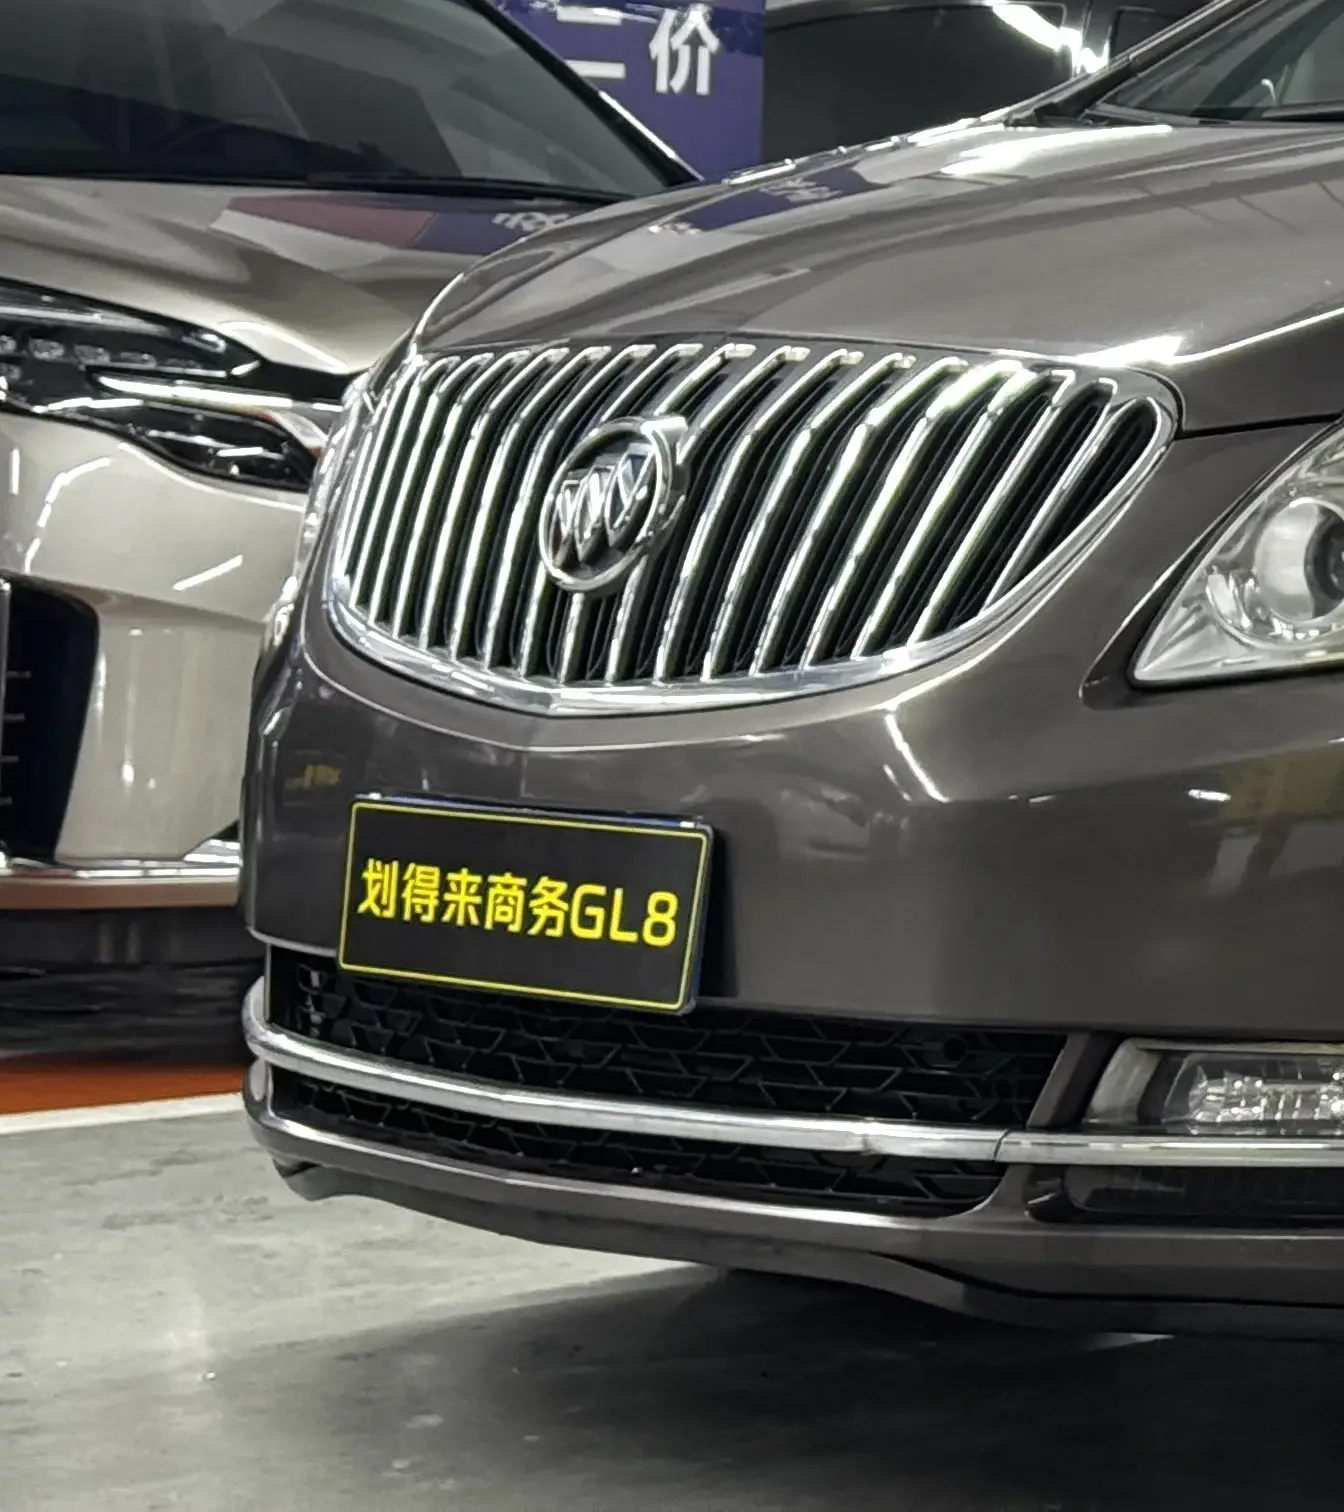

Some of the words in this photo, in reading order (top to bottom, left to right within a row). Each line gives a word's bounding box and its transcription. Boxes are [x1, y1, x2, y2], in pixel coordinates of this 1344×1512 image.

[357, 857, 680, 948] 划得来商务GL8
